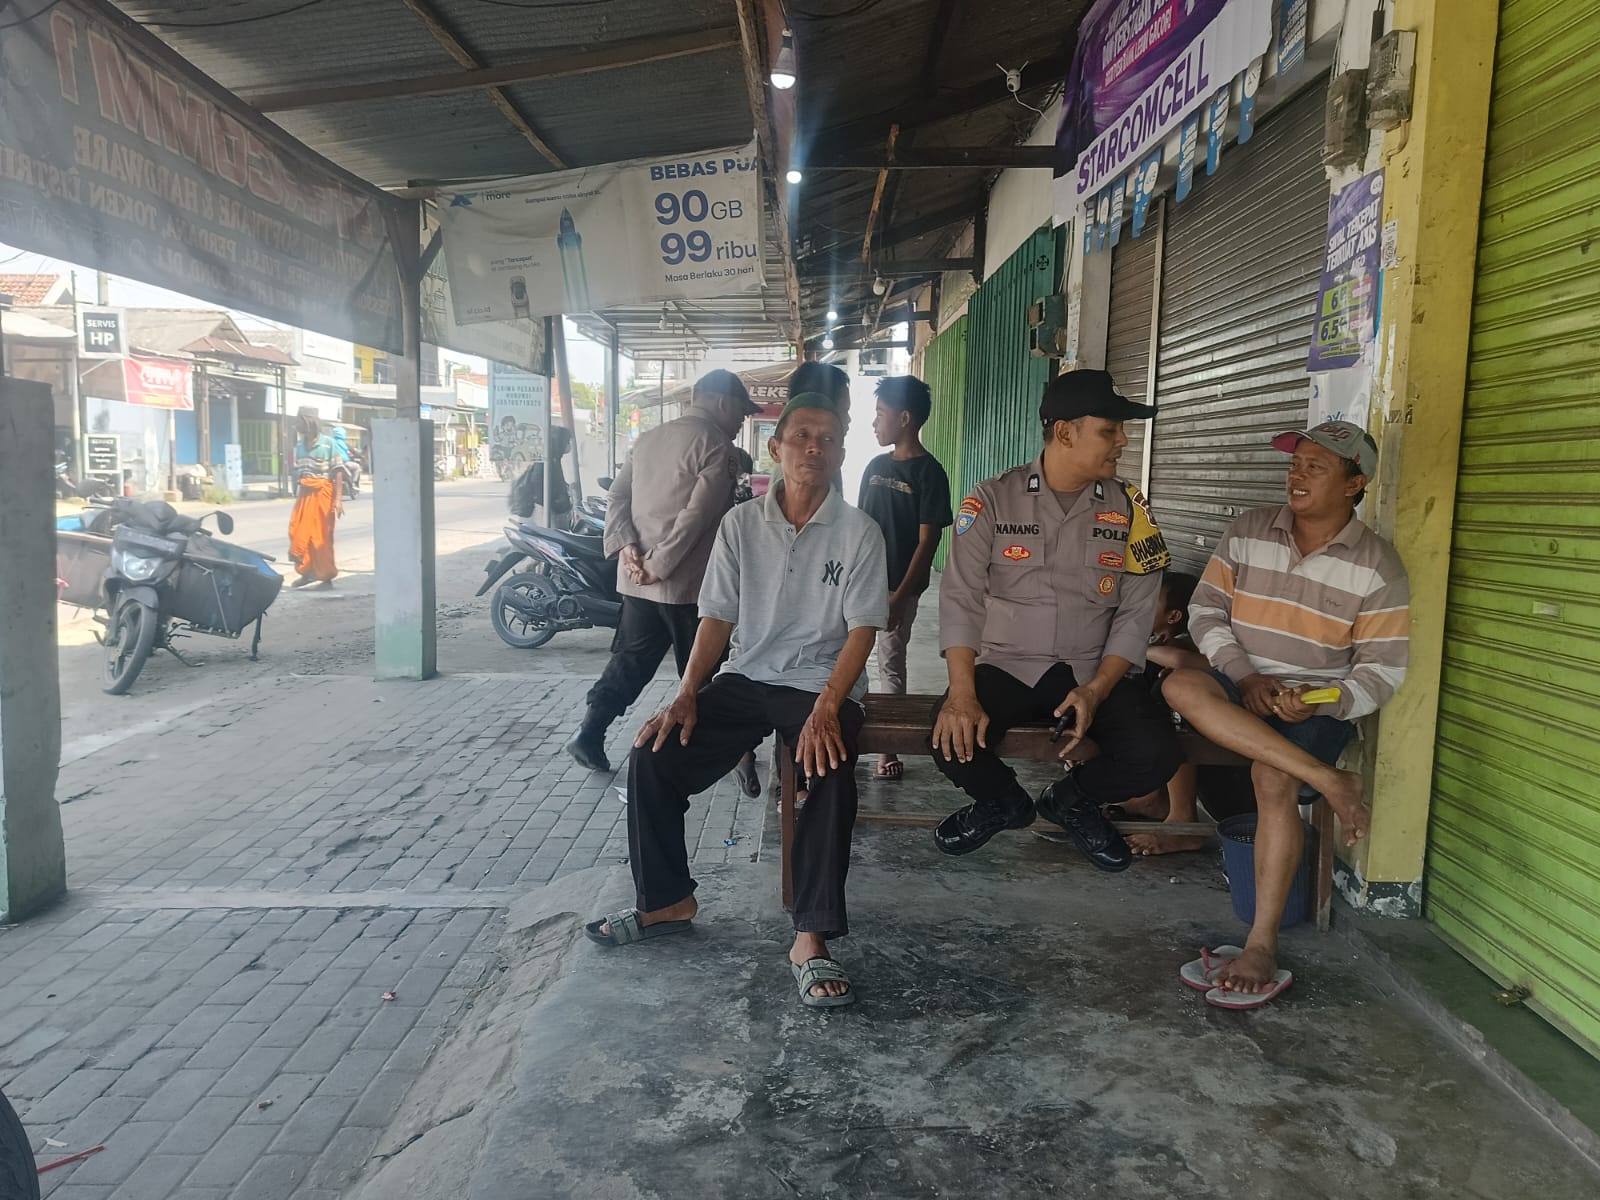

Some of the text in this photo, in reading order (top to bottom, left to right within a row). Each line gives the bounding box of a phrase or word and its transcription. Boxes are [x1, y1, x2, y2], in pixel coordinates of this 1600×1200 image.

[1077, 39, 1209, 194] STARCOMCELL
[650, 161, 717, 180] BEBAS
[655, 189, 743, 225] 90 GB
[661, 229, 757, 265] 99 ribu
[665, 265, 754, 282] Masa Berlaku 30 hari
[87, 319, 116, 328] SERVIS
[90, 332, 114, 346] HP
[996, 523, 1039, 535] NANANG
[822, 559, 844, 586] NY
